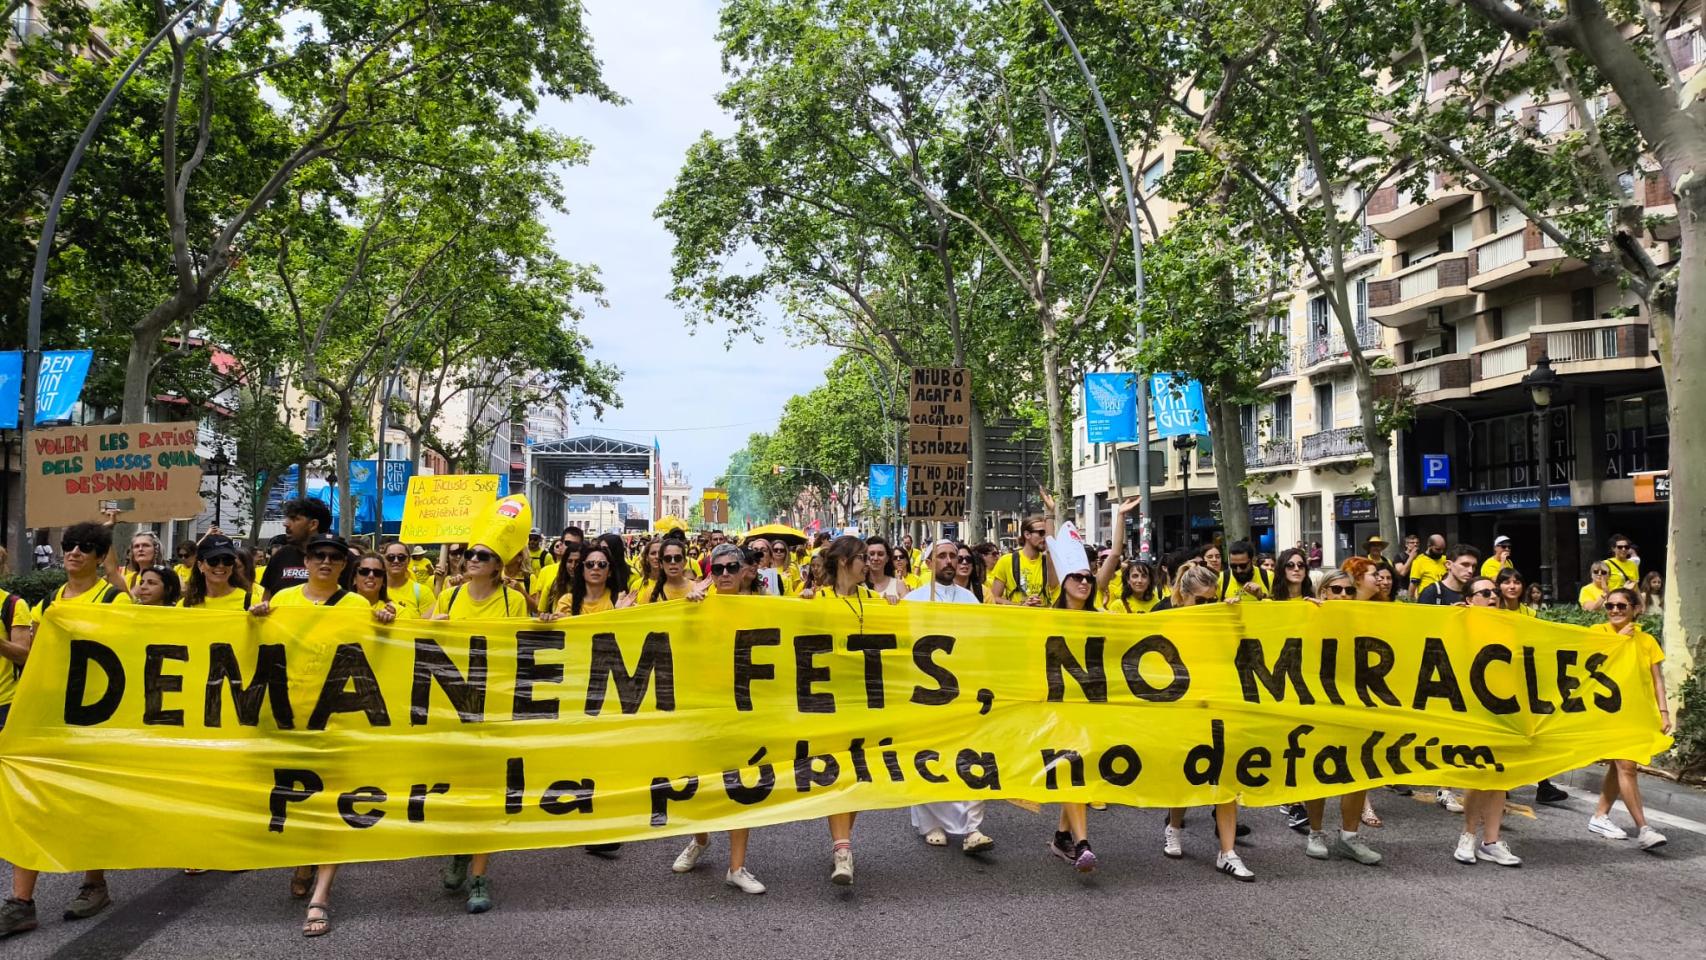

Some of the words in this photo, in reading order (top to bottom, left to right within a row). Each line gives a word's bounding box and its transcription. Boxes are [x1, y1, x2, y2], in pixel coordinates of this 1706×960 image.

[40, 356, 75, 374] BEN
[915, 388, 962, 402] AGAFA
[930, 404, 946, 415] UN
[1159, 409, 1192, 428] GUT
[914, 414, 964, 426] CAGARRO
[35, 434, 88, 455] VOLEM
[100, 432, 129, 451] LES
[912, 441, 968, 455] ESMORZA
[42, 456, 83, 476] DELS
[95, 453, 152, 471] MOSSOS
[158, 450, 201, 469] QUAN
[387, 462, 405, 473] BEN
[1430, 459, 1443, 477] P
[911, 465, 941, 480] T'HO
[66, 472, 168, 494] DESNONEN
[413, 481, 425, 494] LA
[911, 481, 928, 496] EL
[933, 481, 966, 497] PAPA
[908, 498, 939, 517] LLEÓ
[941, 500, 965, 517] XIV
[63, 630, 676, 730] DEMANEM
[733, 627, 995, 715] FETS,
[1046, 634, 1191, 703] NO
[1234, 636, 1622, 714] MIRACLES
[267, 768, 451, 833] Per
[505, 757, 595, 816] la
[650, 736, 1001, 827] pública
[1040, 744, 1142, 790] no
[1184, 719, 1504, 788] defallim.
